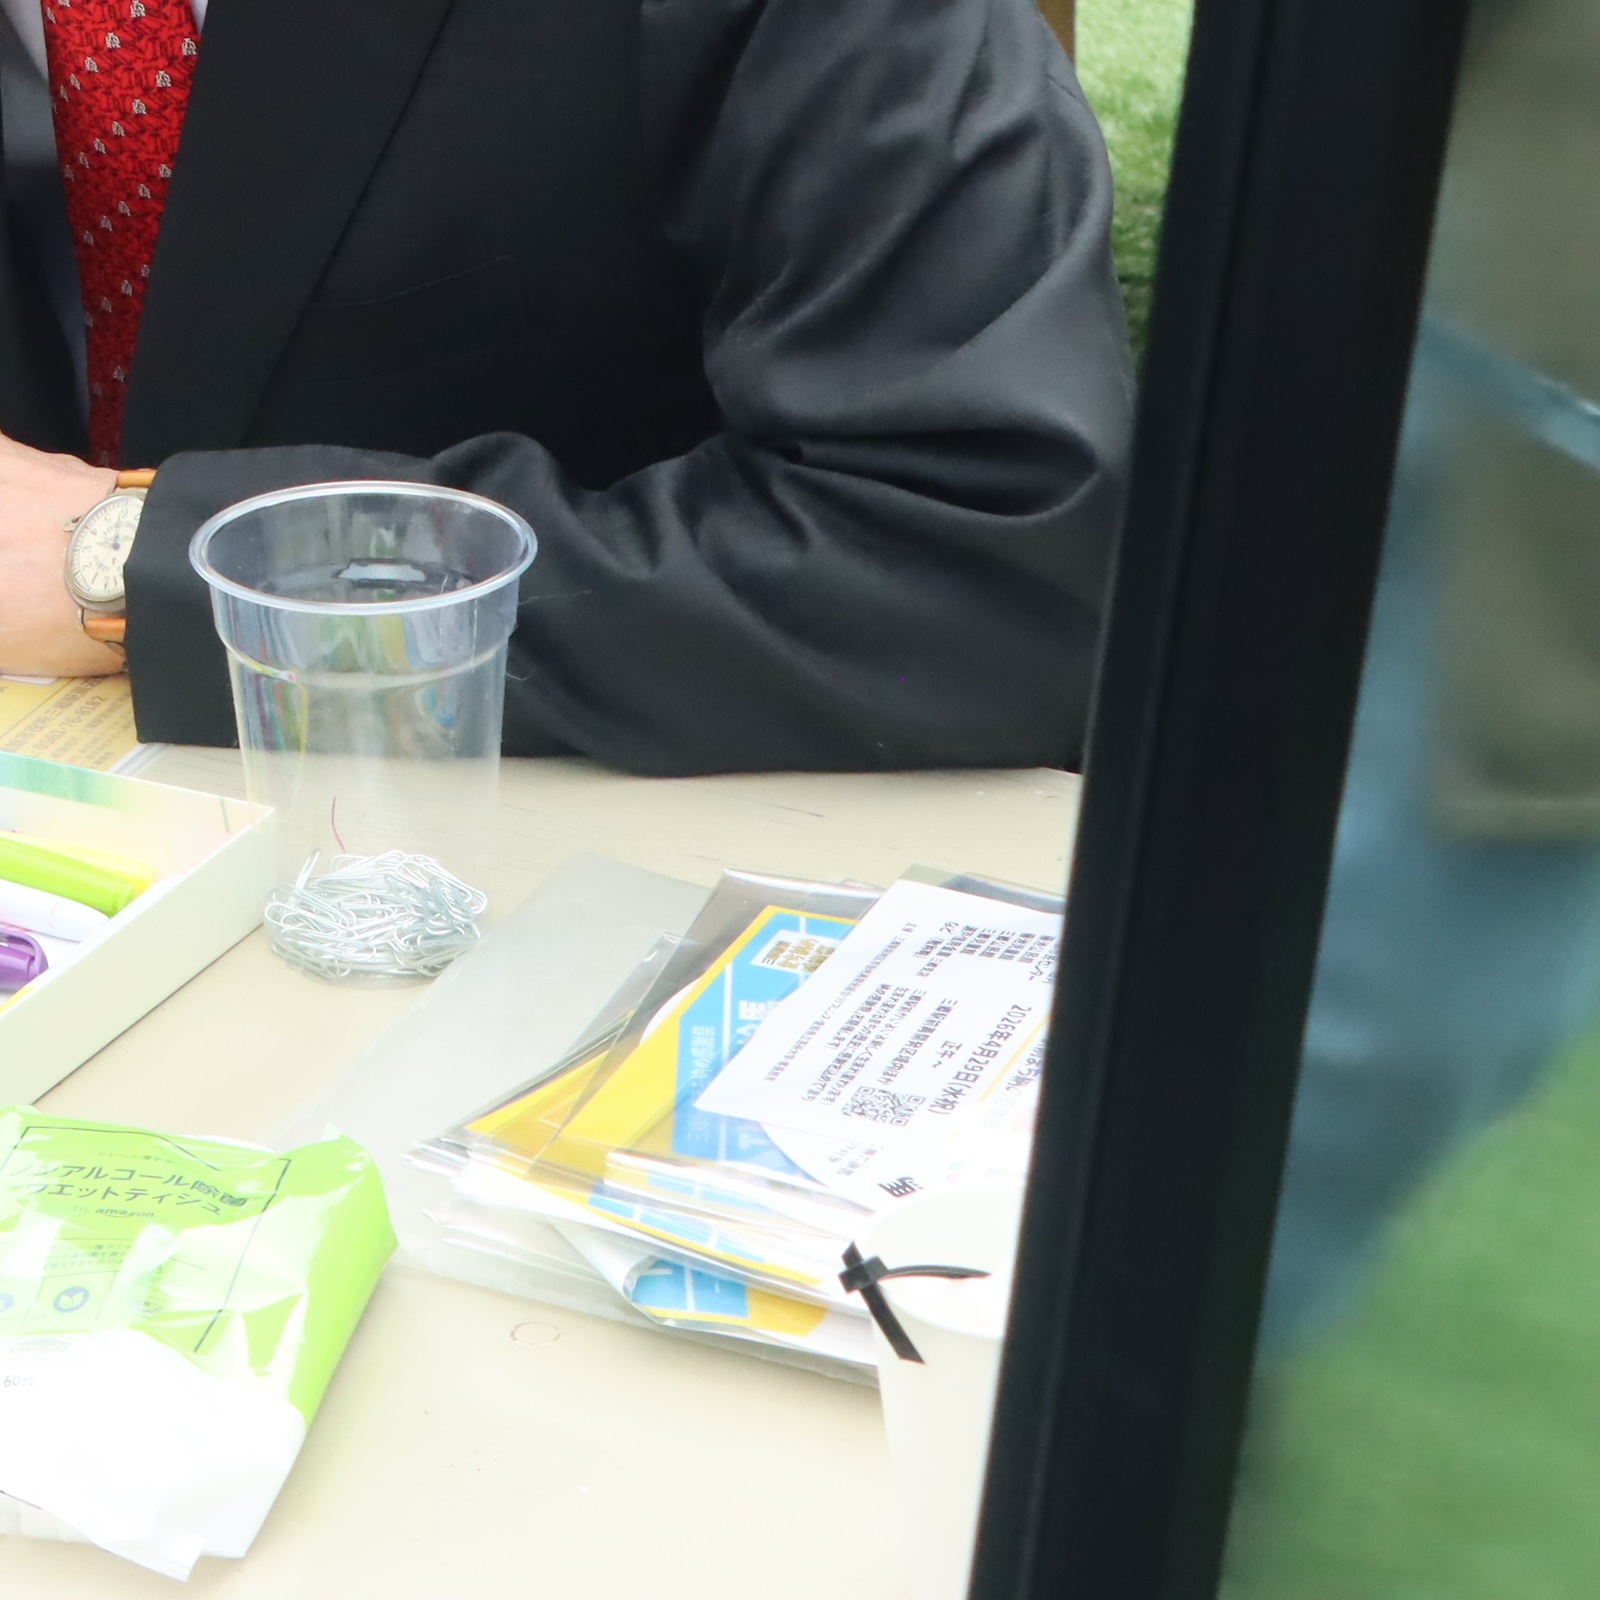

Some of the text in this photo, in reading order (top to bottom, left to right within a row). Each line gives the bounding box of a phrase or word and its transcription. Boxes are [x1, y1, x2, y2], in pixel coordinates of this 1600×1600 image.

[928, 1004, 1033, 1116] 2026年4月29日(水祝)
[8, 1163, 248, 1208] ノンアルコール除菌
[26, 1182, 222, 1216] ウエットティシュ
[94, 1207, 155, 1218] amazon
